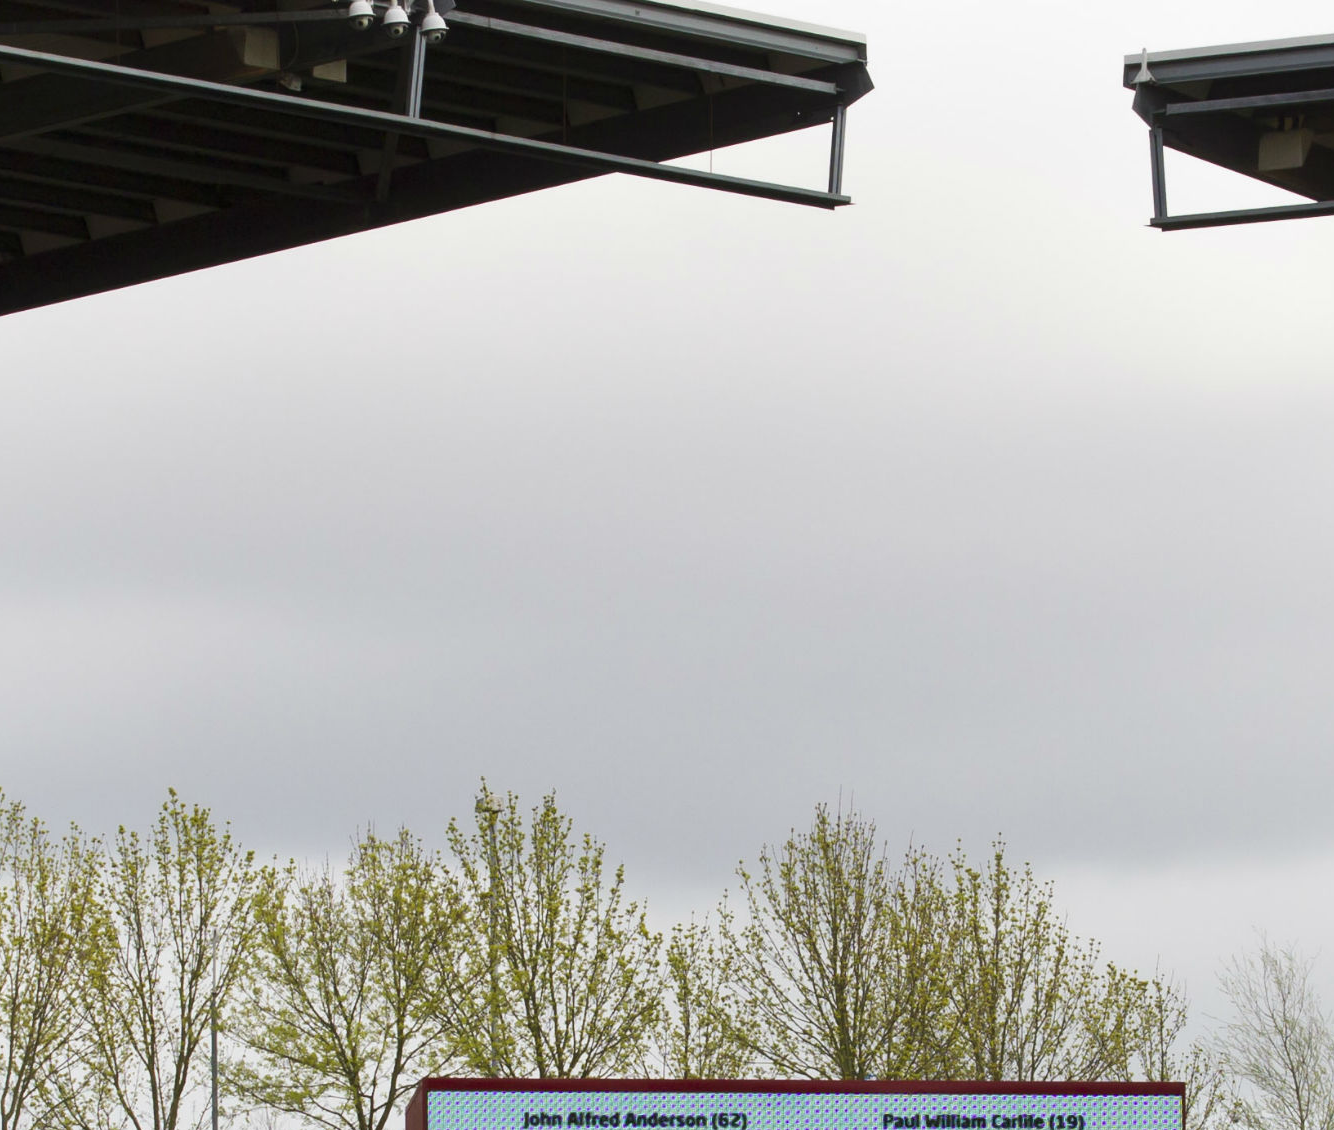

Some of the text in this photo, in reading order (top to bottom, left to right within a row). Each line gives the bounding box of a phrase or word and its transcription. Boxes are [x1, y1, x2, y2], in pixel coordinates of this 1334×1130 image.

[524, 1112, 747, 1130] John Alfred Anderson (62)
[884, 1114, 920, 1128] Paul
[925, 1115, 986, 1128] William
[992, 1115, 1044, 1129] Carlile
